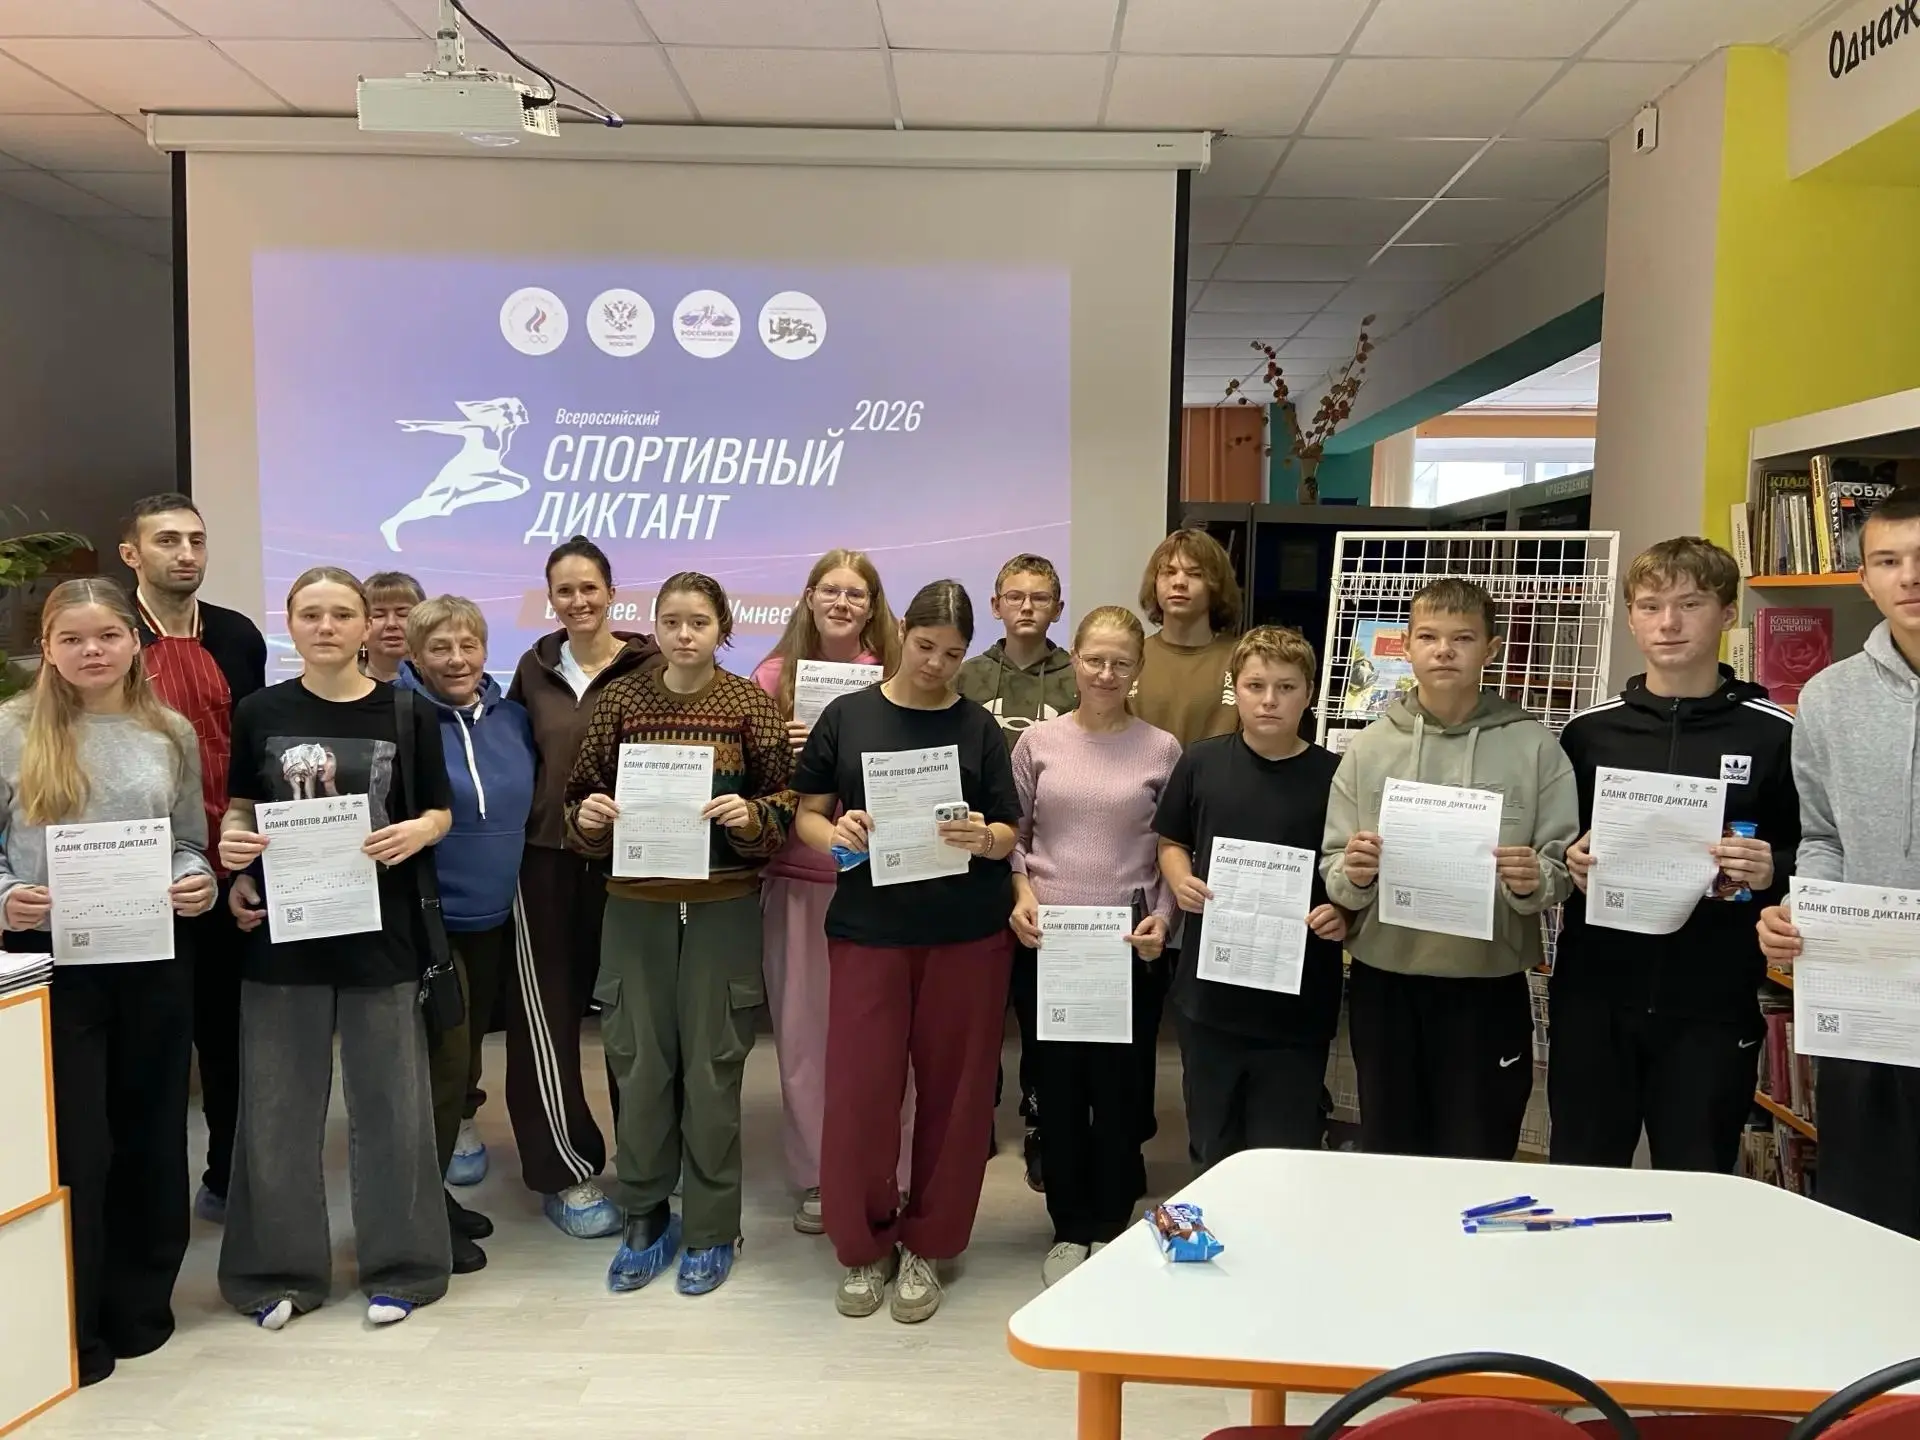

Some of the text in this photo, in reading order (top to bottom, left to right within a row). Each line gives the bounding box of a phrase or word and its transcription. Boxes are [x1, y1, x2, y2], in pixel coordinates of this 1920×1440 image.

[1828, 0, 1920, 79] Однаж
[555, 407, 661, 428] Всероссийский
[850, 399, 925, 432] 2026
[542, 427, 845, 487] СПОРТИВНЫЙ
[523, 491, 730, 545] ДИКТАНТ
[624, 761, 702, 771] БЛАНК ОТВЕТОВ ДИКТАНТА
[868, 764, 949, 778] БЛАНК ОТВЕТОВ ДИКТАНТА
[1388, 795, 1487, 811] БЛАНК ОТВЕТОВ ДИКТАНТА
[1601, 788, 1708, 808] БЛАНК ОТВЕТОВ ДИКТАНТА
[265, 813, 358, 830] БЛАНК ОТВЕТОВ ДИКТАНТА
[54, 838, 158, 853] БЛАНК ОТВЕТОВ ДИКТАНТА
[1215, 855, 1301, 873] БЛАНК ОТВЕТОВ ДИКТАНТА
[1798, 901, 1828, 913] БЛАНК
[1830, 905, 1870, 918] ОТВЕТОВ
[1063, 923, 1089, 931] ОТВЕТОВ
[1090, 923, 1120, 931] ДИКТАНТА
